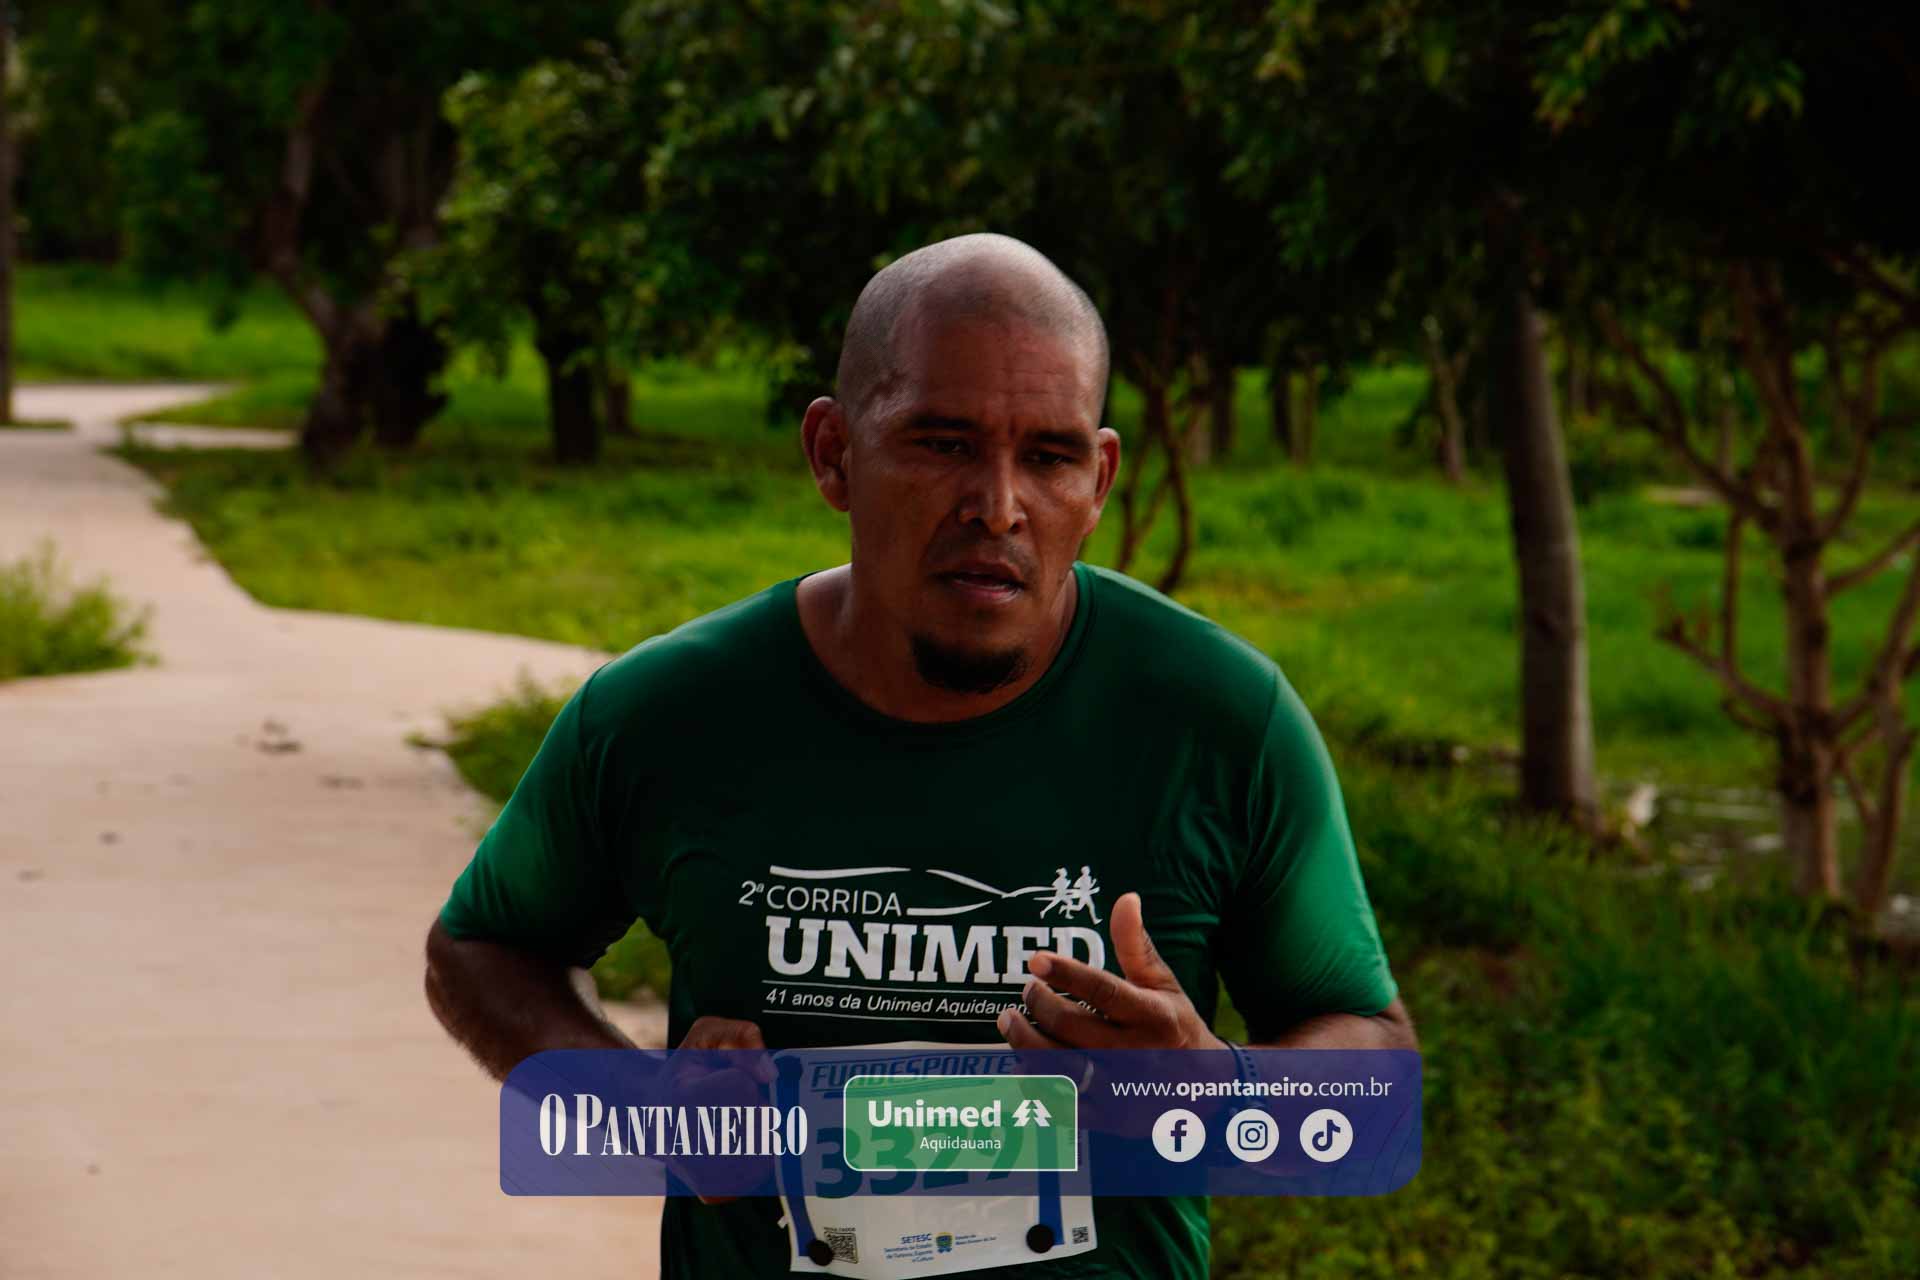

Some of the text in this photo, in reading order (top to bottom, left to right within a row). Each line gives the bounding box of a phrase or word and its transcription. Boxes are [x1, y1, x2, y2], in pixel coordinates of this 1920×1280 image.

[766, 884, 902, 917] CORRIDA
[765, 915, 1105, 985] UNIMED
[766, 988, 787, 1005] 41
[791, 993, 834, 1008] anos
[839, 993, 862, 1010] da
[867, 995, 932, 1014] Unimed
[815, 1110, 1025, 1198] 3329
